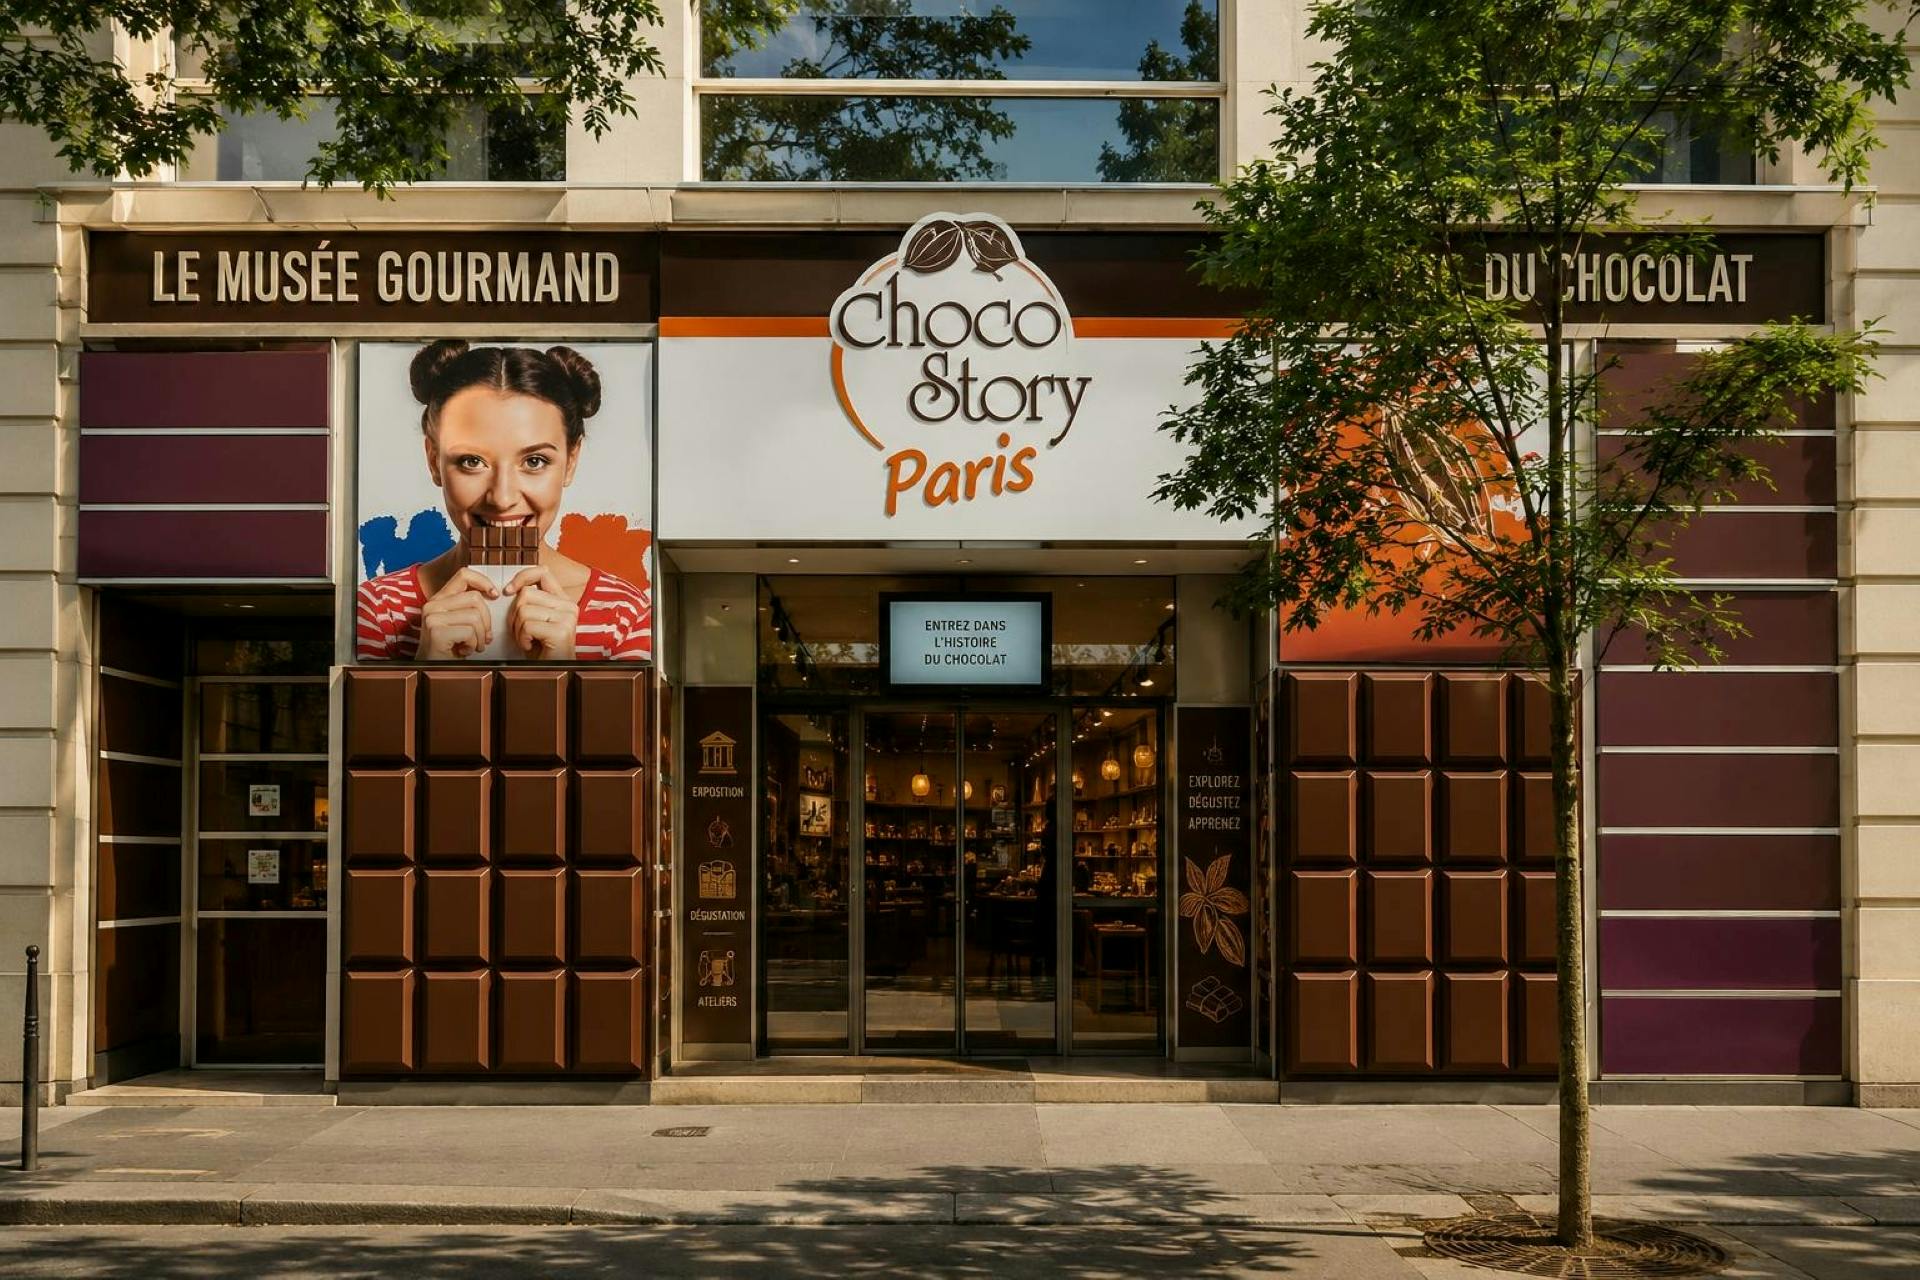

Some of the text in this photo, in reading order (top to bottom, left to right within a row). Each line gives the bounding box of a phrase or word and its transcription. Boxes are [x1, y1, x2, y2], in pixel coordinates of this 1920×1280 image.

[152, 240, 621, 304] LE MUSÉE GOURMAND
[1485, 252, 1753, 303] DU CHOCOLAT
[838, 270, 1062, 349] Choco
[908, 351, 1092, 447] Story
[884, 432, 1037, 517] Paris
[925, 620, 1006, 632] ENTREZ DANS
[934, 636, 998, 648] L'HISTOIRE
[924, 654, 1007, 666] DU CHOCOLAT
[1189, 775, 1241, 788] EXPLOREZ
[1189, 792, 1241, 808] DÉGUSTEZ
[1188, 816, 1241, 830] APPRENEZ
[690, 908, 746, 921] DÉGUSTATION
[697, 996, 737, 1007] ATELIERS
